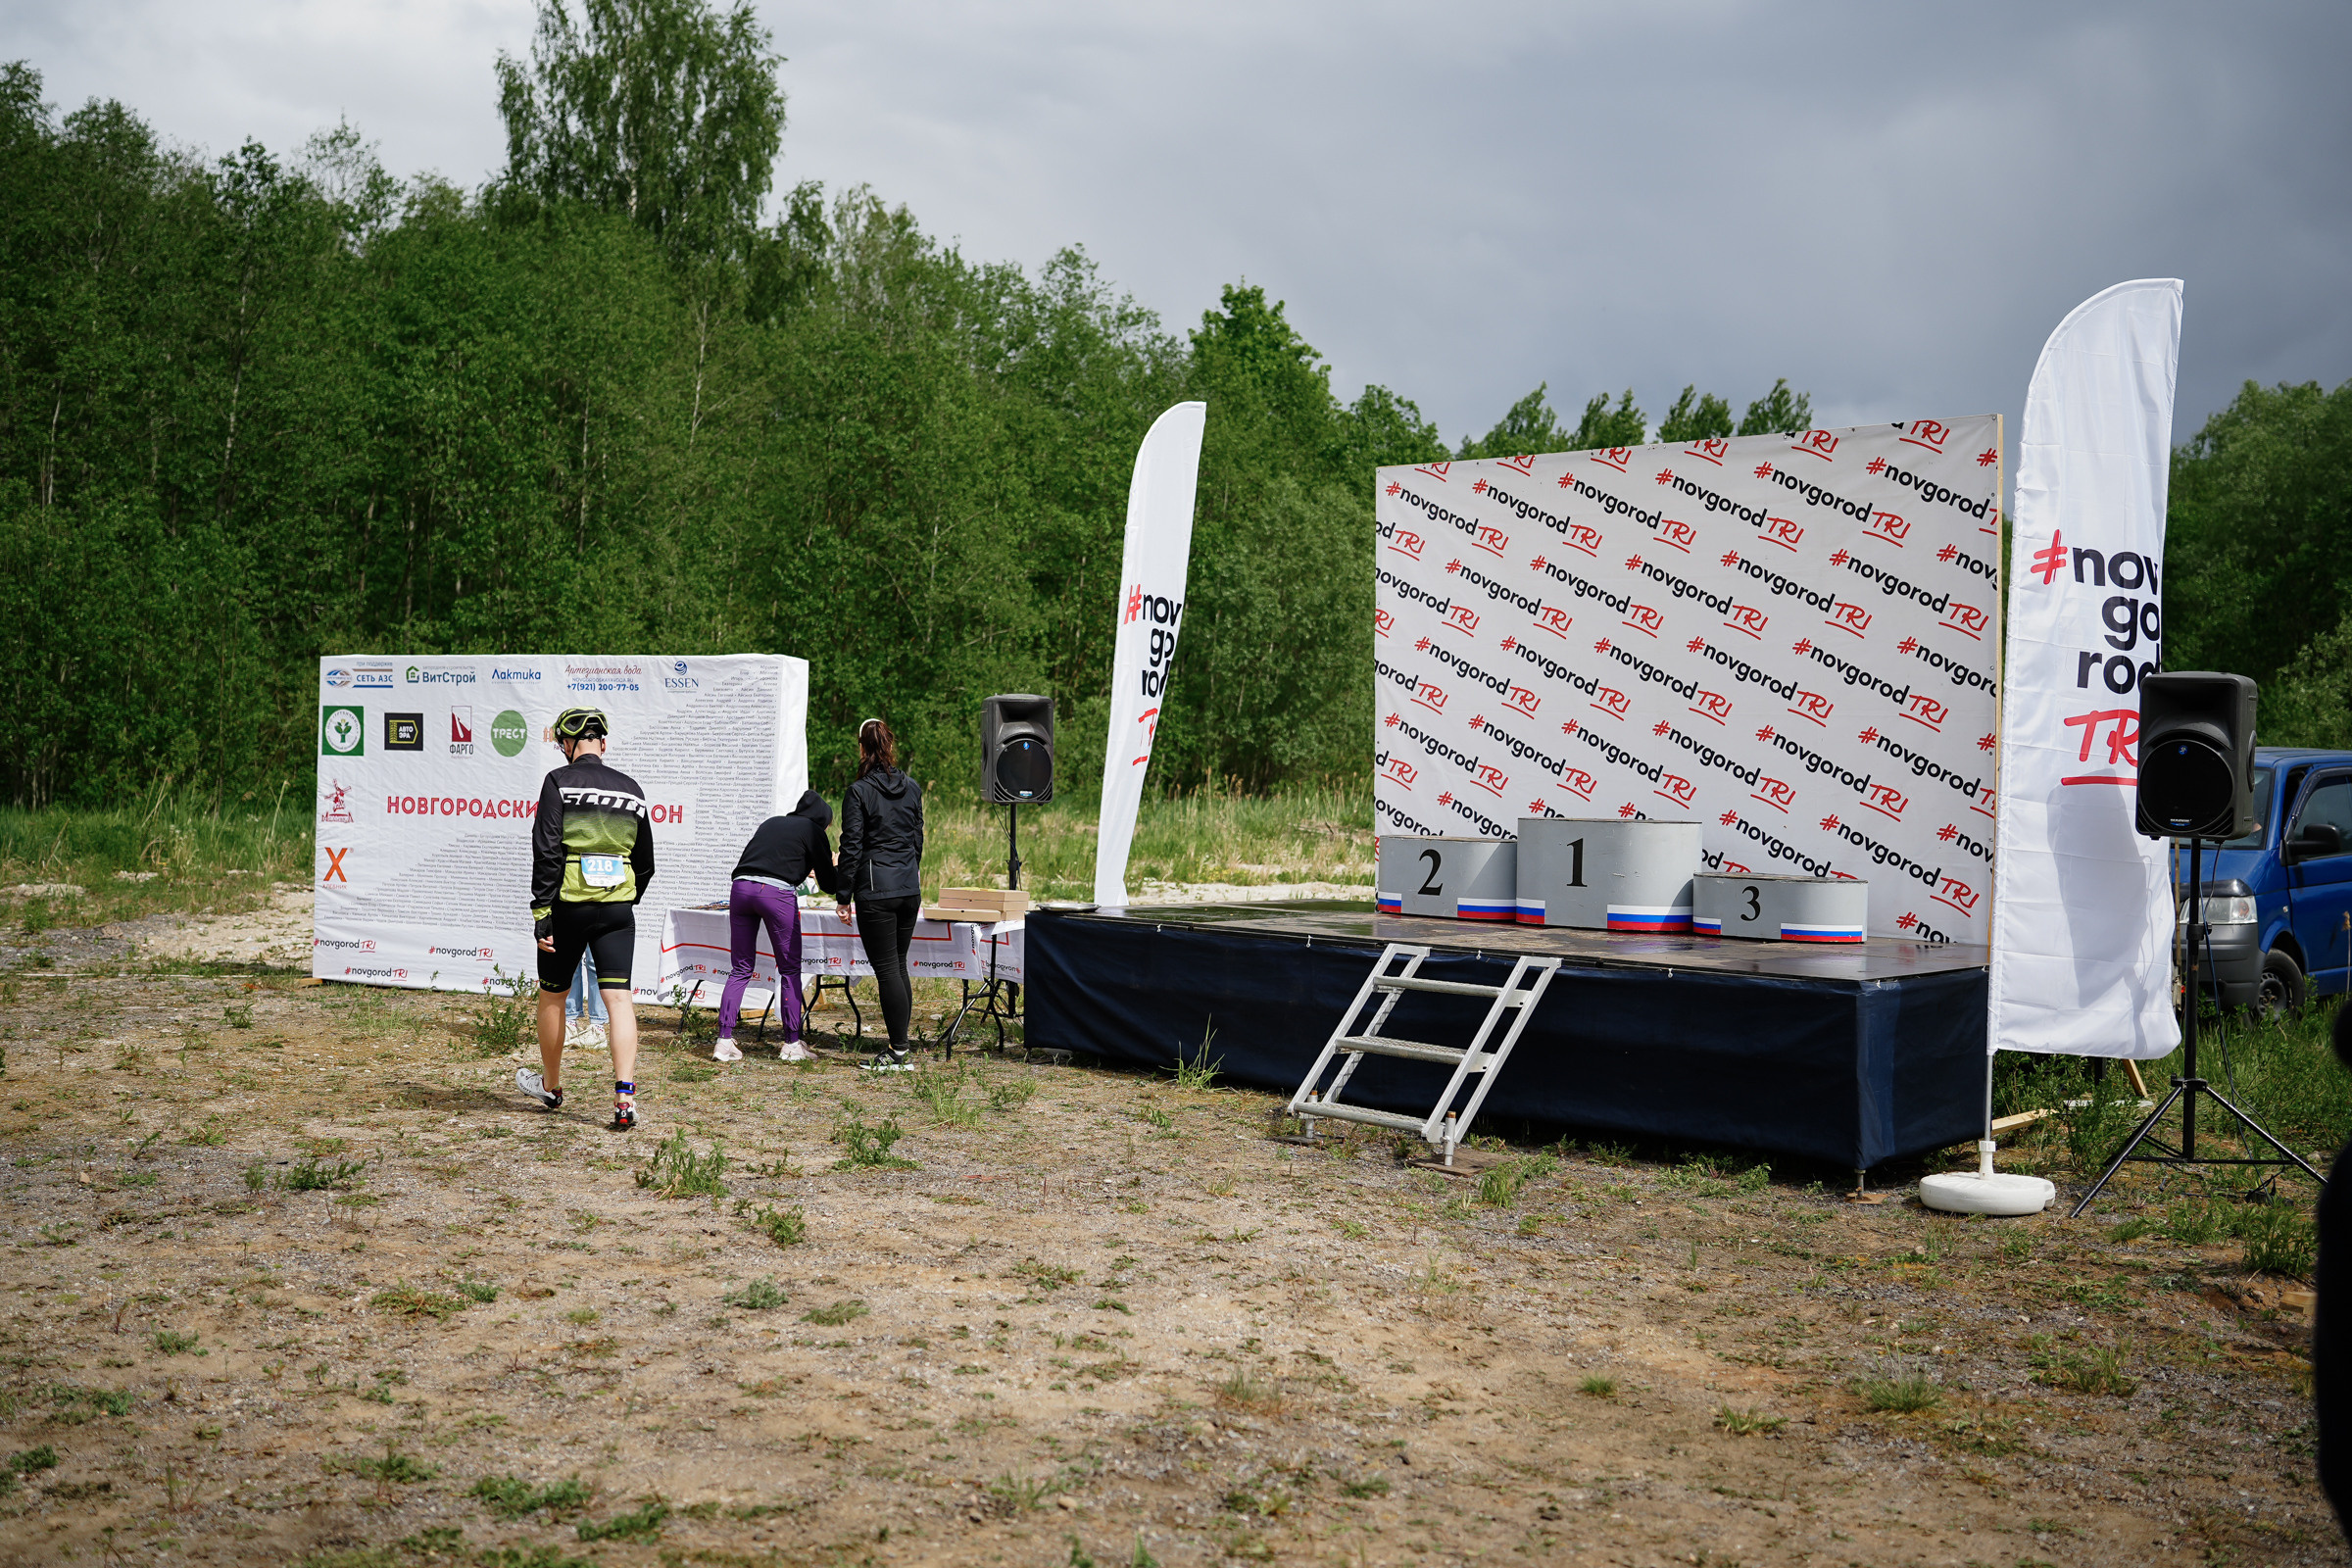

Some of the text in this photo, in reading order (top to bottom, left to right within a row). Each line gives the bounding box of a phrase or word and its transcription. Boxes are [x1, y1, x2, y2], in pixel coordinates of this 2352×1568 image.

[1386, 481, 1509, 550] #novgorodTRI
[1473, 478, 1602, 549] #novgorodTRI
[1558, 472, 1695, 544] #novgorodTRI
[1655, 468, 1804, 543] #novgorodTRI
[1754, 462, 1911, 539] #novgorodTRI
[1446, 559, 1572, 630] #novgorodTRI
[1531, 556, 1663, 629] #novgorodTRI
[1625, 554, 1768, 630] #novgorodTRI
[1721, 550, 1872, 629] #novgorodTRI
[1829, 549, 1988, 631] #novgorodTRI
[2031, 529, 2158, 595] #nov
[1124, 584, 1182, 626] #nov
[2101, 596, 2160, 651] go
[356, 674, 375, 683] СЕТЬ
[378, 674, 393, 683] АЗС
[422, 670, 476, 686] ВитСтрой
[492, 668, 541, 680] Лактика
[564, 663, 642, 678] Артезианская вода
[664, 677, 699, 688] ESSEN
[1415, 637, 1541, 711] #novgorodTRI
[1500, 636, 1631, 712] #novgorodTRI
[1593, 637, 1733, 717] #novgorodTRI
[1687, 636, 1834, 718] #novgorodTRI
[1792, 638, 1948, 723] #novgorodTRI
[450, 744, 473, 755] ФАРГО
[492, 728, 526, 739] ТРЕСТ
[1385, 712, 1508, 790] #novgorodTRI
[1469, 714, 1596, 794] #novgorodTRI
[1562, 719, 1696, 801] #novgorodTRI
[1652, 720, 1795, 805] #novgorodTRI
[1755, 724, 1908, 812] #novgorodTRI
[563, 788, 646, 817] SCOTT
[588, 859, 613, 872] 218
[1417, 849, 1444, 896] 2
[1566, 838, 1588, 887] 1
[1820, 814, 1980, 908] #novgorodTRI
[1740, 886, 1761, 921] 3
[314, 938, 376, 951] #novgorodTRI
[345, 966, 408, 979] #novgorodTRI
[428, 946, 493, 958] #novgorodTRI
[660, 964, 707, 983] #novgorodTRI
[913, 960, 965, 969] #novgorodTRI
